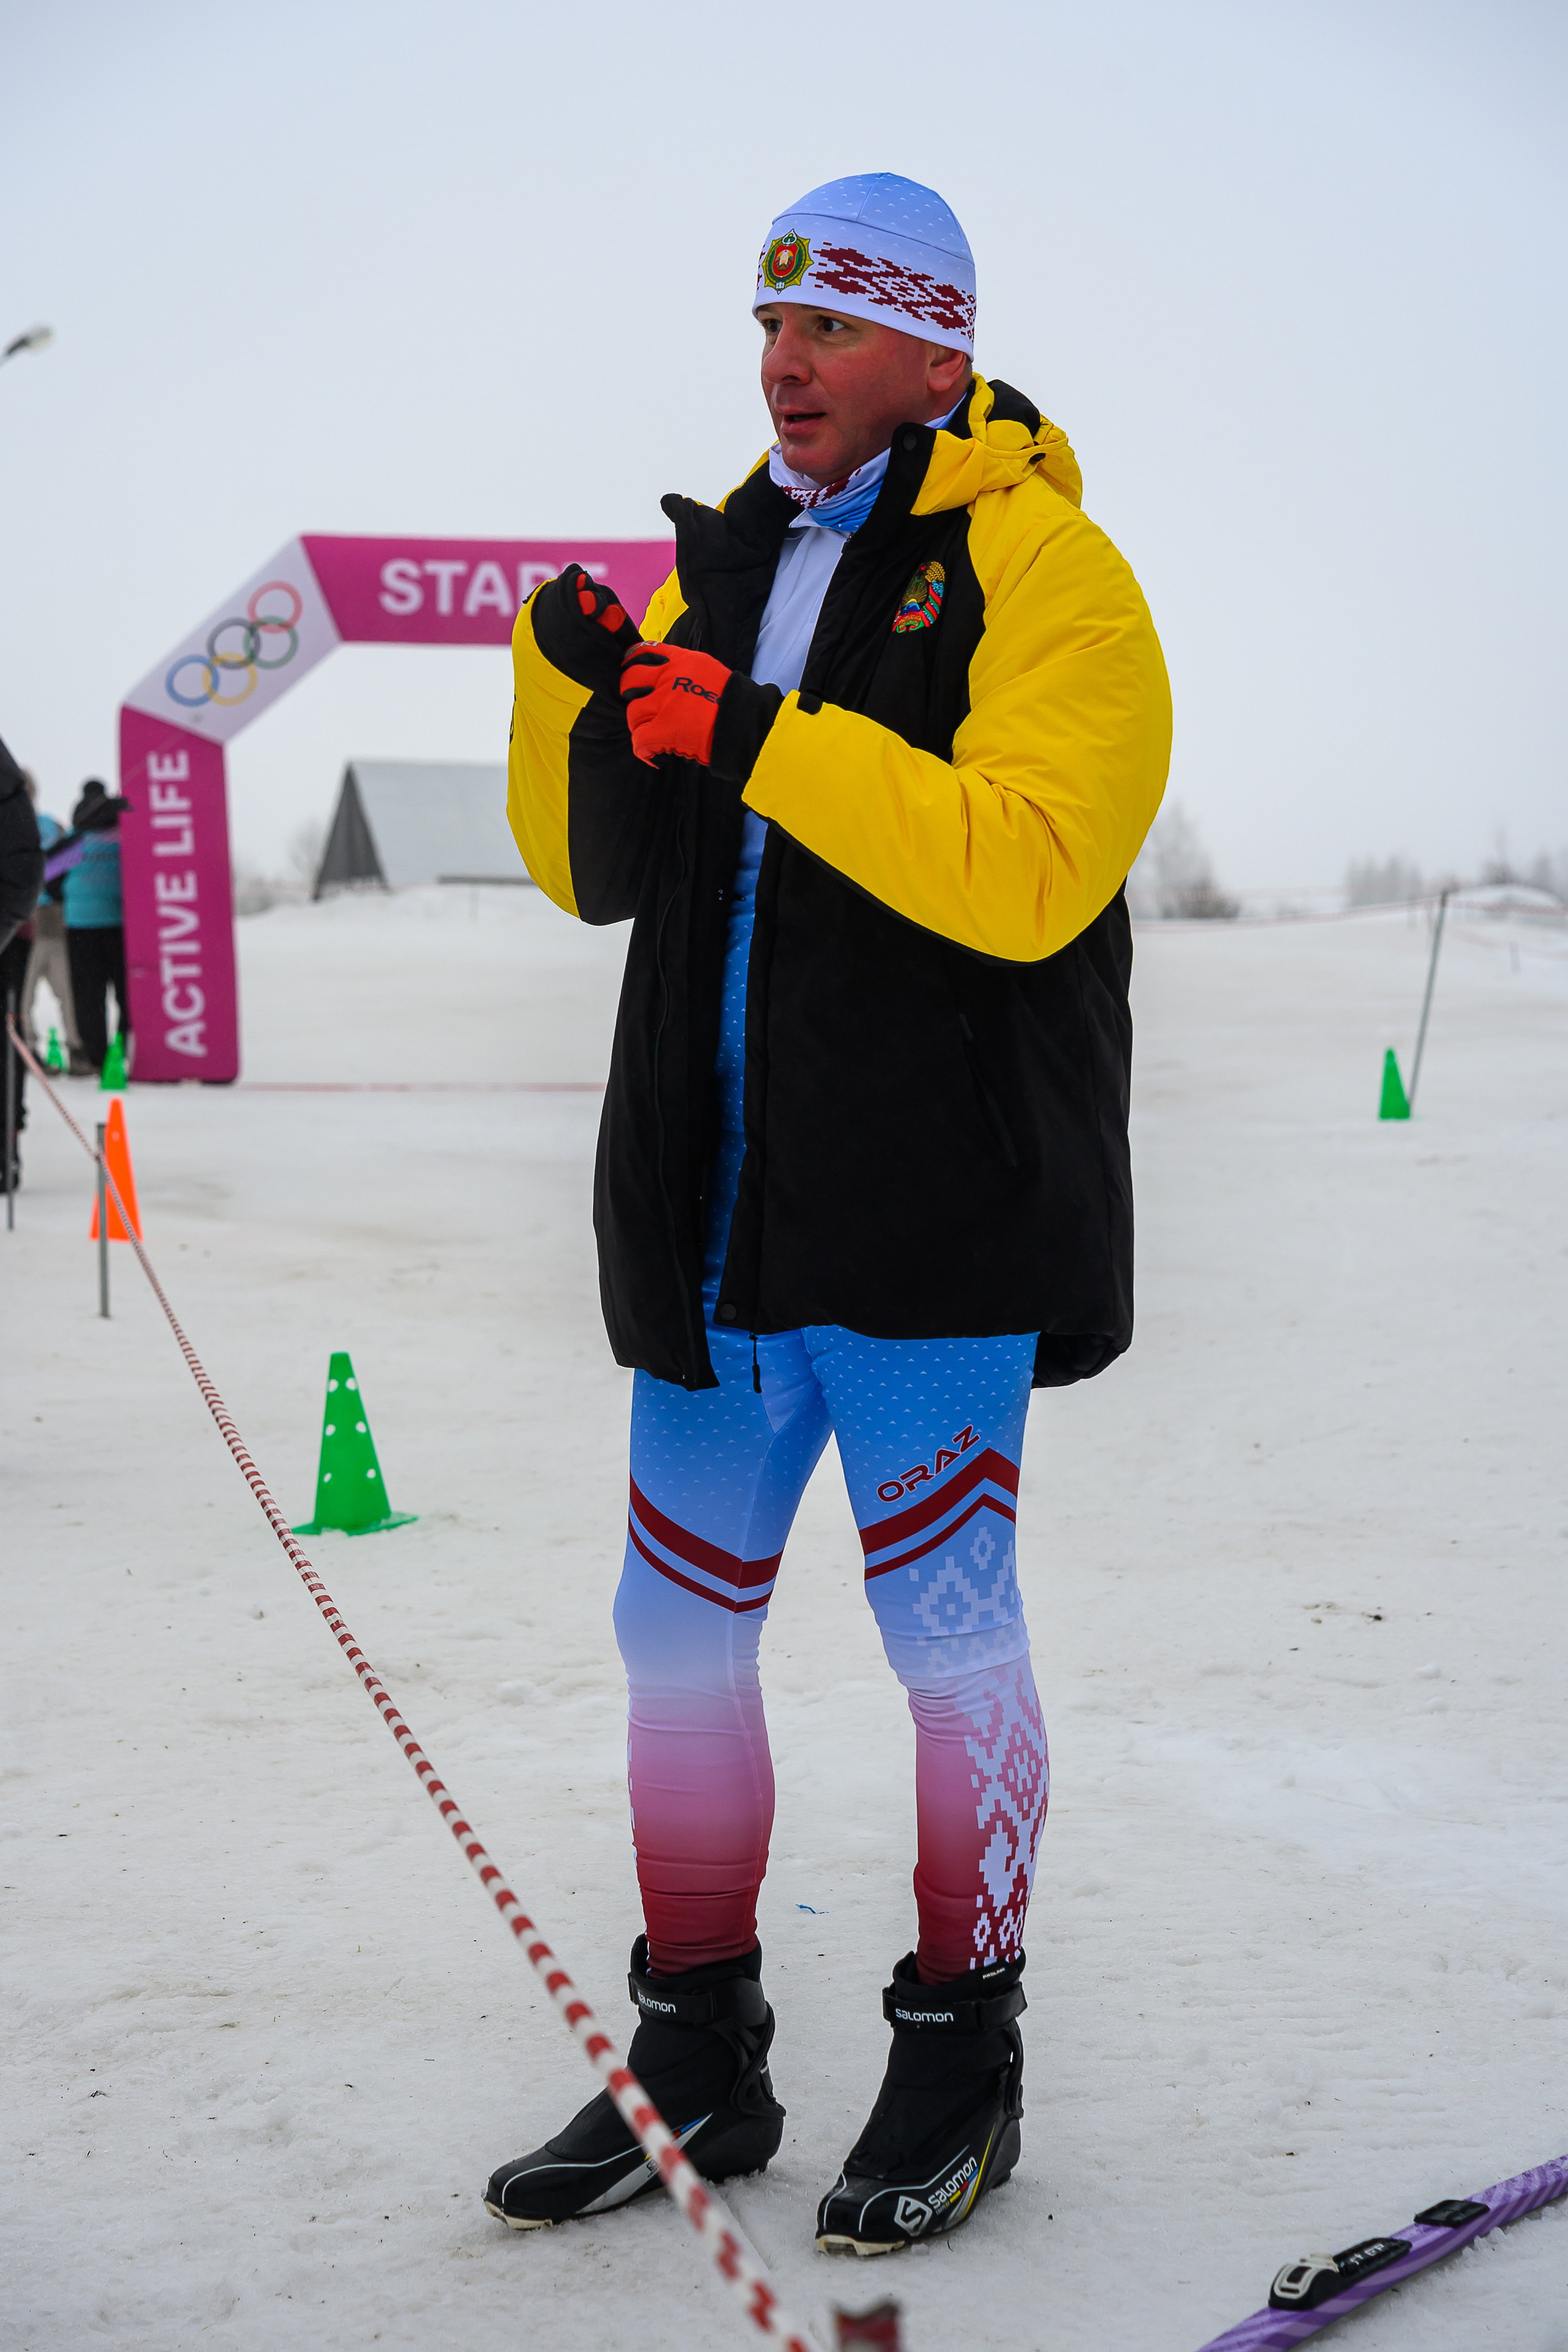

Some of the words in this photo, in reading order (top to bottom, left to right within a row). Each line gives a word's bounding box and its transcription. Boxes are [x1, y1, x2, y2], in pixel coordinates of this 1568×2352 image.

[379, 557, 609, 616] STA
[147, 749, 195, 856] LIFE
[155, 870, 208, 1058] ACTIVE
[876, 1424, 980, 1502] ORAZ
[895, 2008, 954, 2022] salomon
